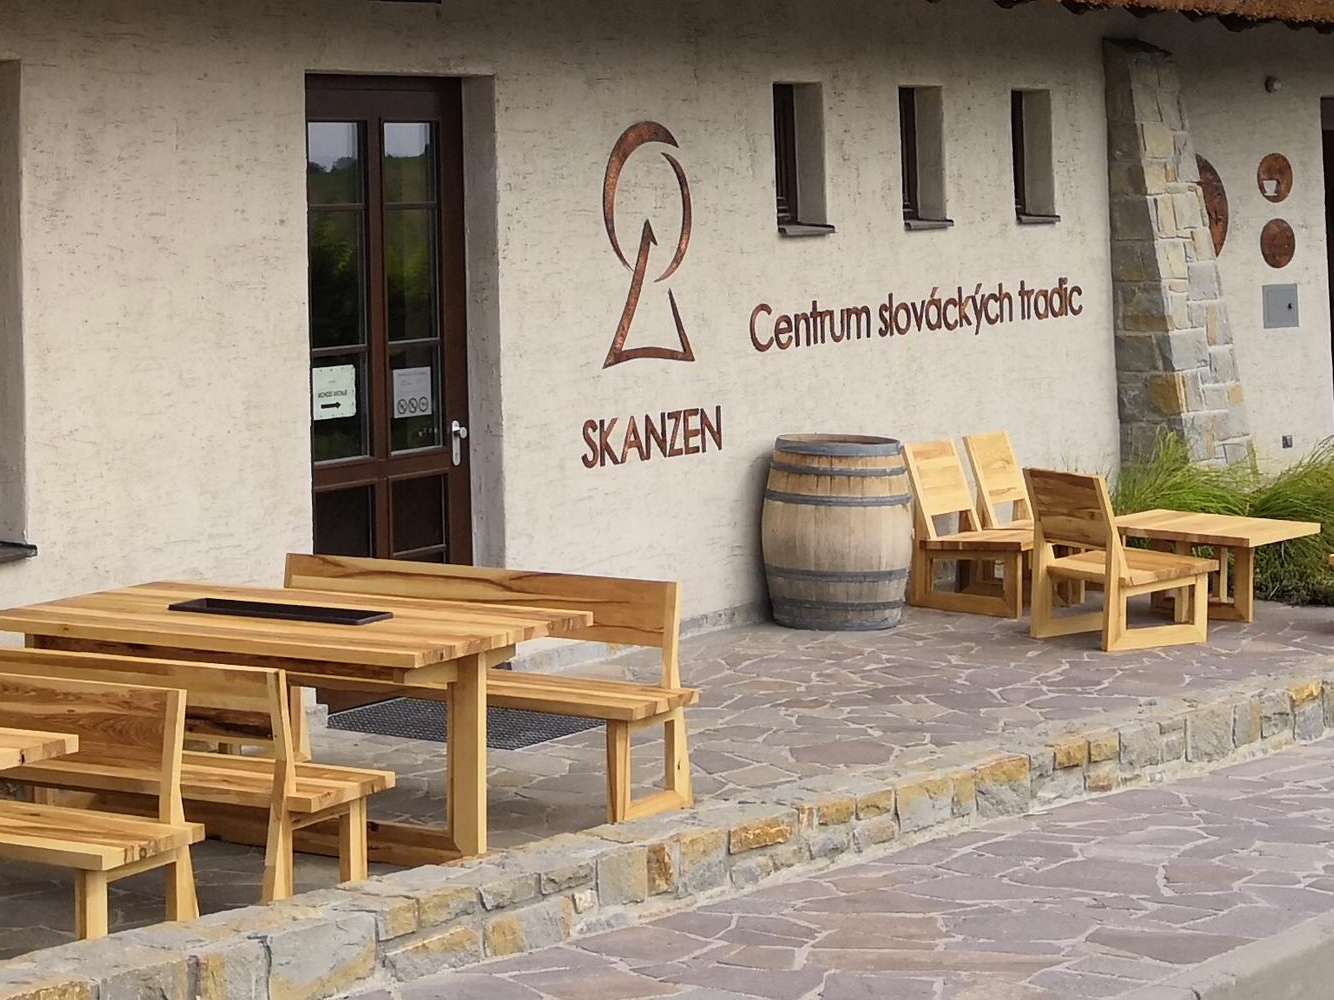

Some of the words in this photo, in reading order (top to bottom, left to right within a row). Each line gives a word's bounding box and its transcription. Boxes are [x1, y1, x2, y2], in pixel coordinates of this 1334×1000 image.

[749, 300, 871, 353] Centrum
[878, 282, 1013, 338] slováckých
[1018, 276, 1083, 321] tradic
[581, 405, 723, 469] SKANZEN
